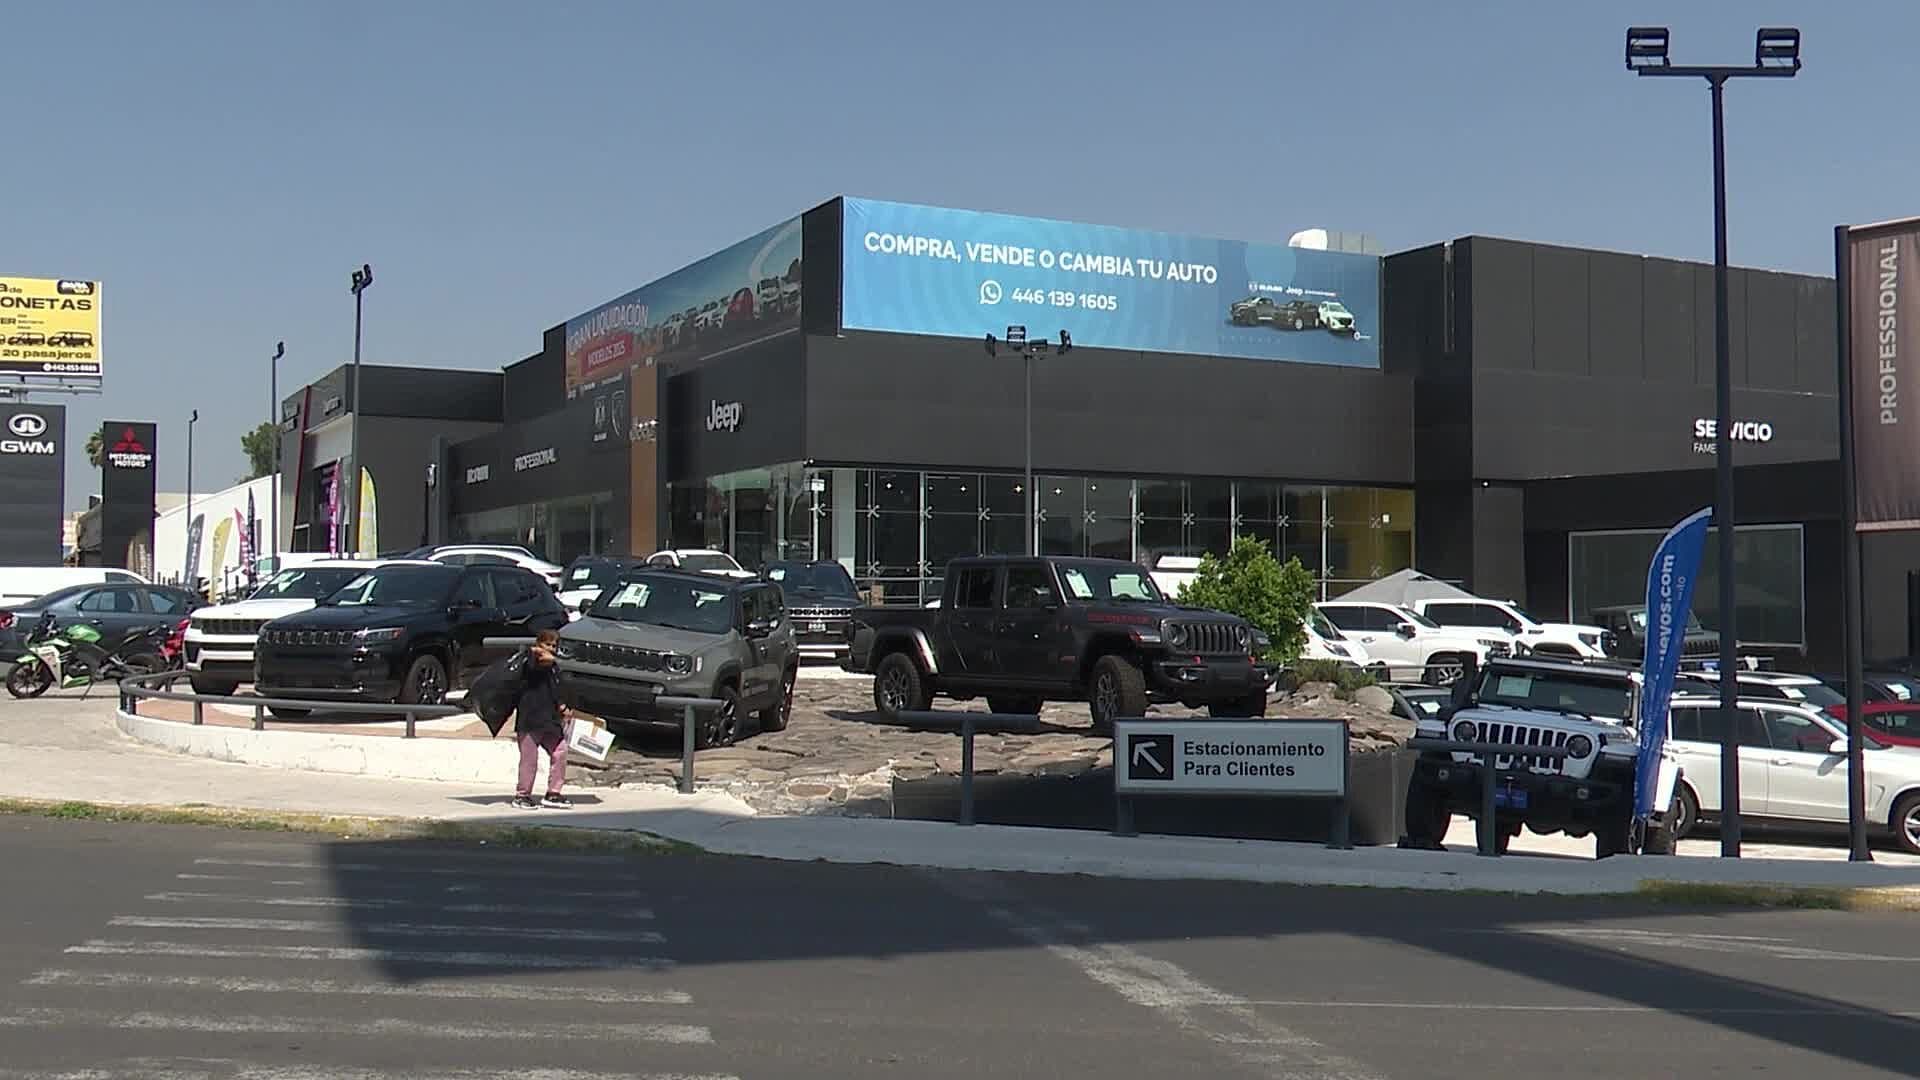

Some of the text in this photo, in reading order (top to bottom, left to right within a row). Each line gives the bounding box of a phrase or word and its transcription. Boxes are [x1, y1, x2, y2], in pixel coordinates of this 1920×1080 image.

[863, 231, 1218, 284] COMPRA, VENDE O CAMBIA TU AUTO
[1011, 287, 1118, 311] 446 139 1605
[1879, 238, 1898, 425] PROFESSIONAL
[2, 348, 93, 360] 20 pasajeros
[706, 399, 741, 433] Jeep
[1694, 418, 1773, 441] SEVICIO
[0, 439, 55, 454] GWM
[108, 452, 152, 462] MITSUBISHI
[114, 459, 147, 468] MOTORS
[1183, 740, 1326, 757] Estacionamiento
[1183, 761, 1296, 777] Para Clientes
